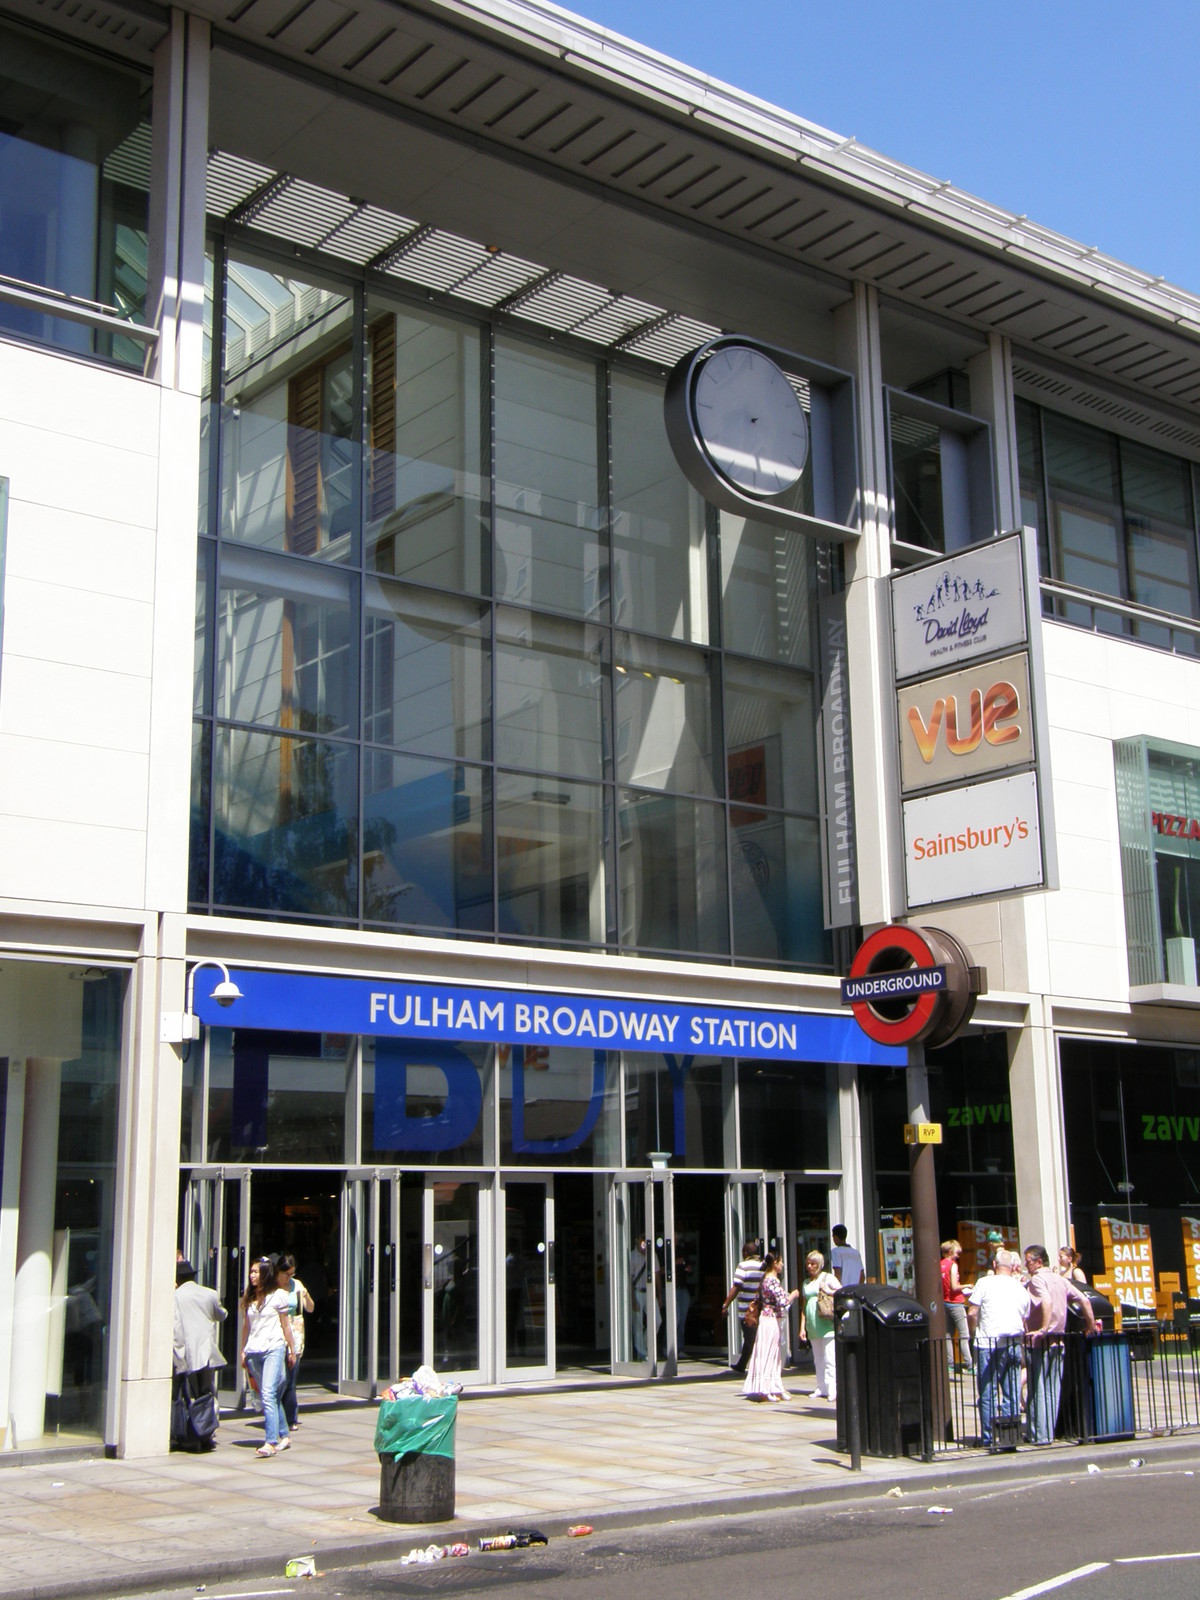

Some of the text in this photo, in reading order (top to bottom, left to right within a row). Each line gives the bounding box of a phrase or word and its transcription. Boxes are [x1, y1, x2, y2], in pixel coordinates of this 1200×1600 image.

[923, 607, 989, 644] David Lloyd
[930, 645, 949, 657] HEALTH
[954, 639, 973, 650] FITNESS
[973, 634, 987, 645] CLUB
[828, 618, 856, 904] FULHAM BROADWAY
[913, 816, 1029, 861] Sainsbury's
[847, 973, 941, 997] UNDERGROUND
[369, 992, 798, 1051] FULHAM BROADWAY STATION
[948, 1102, 1010, 1128] zavvi
[922, 1128, 936, 1137] RVP
[1142, 1115, 1200, 1141] zavv
[1112, 1224, 1147, 1239] SALE
[1113, 1244, 1150, 1262] SALE
[1114, 1265, 1152, 1284] SALE
[1117, 1288, 1153, 1304] SALE
